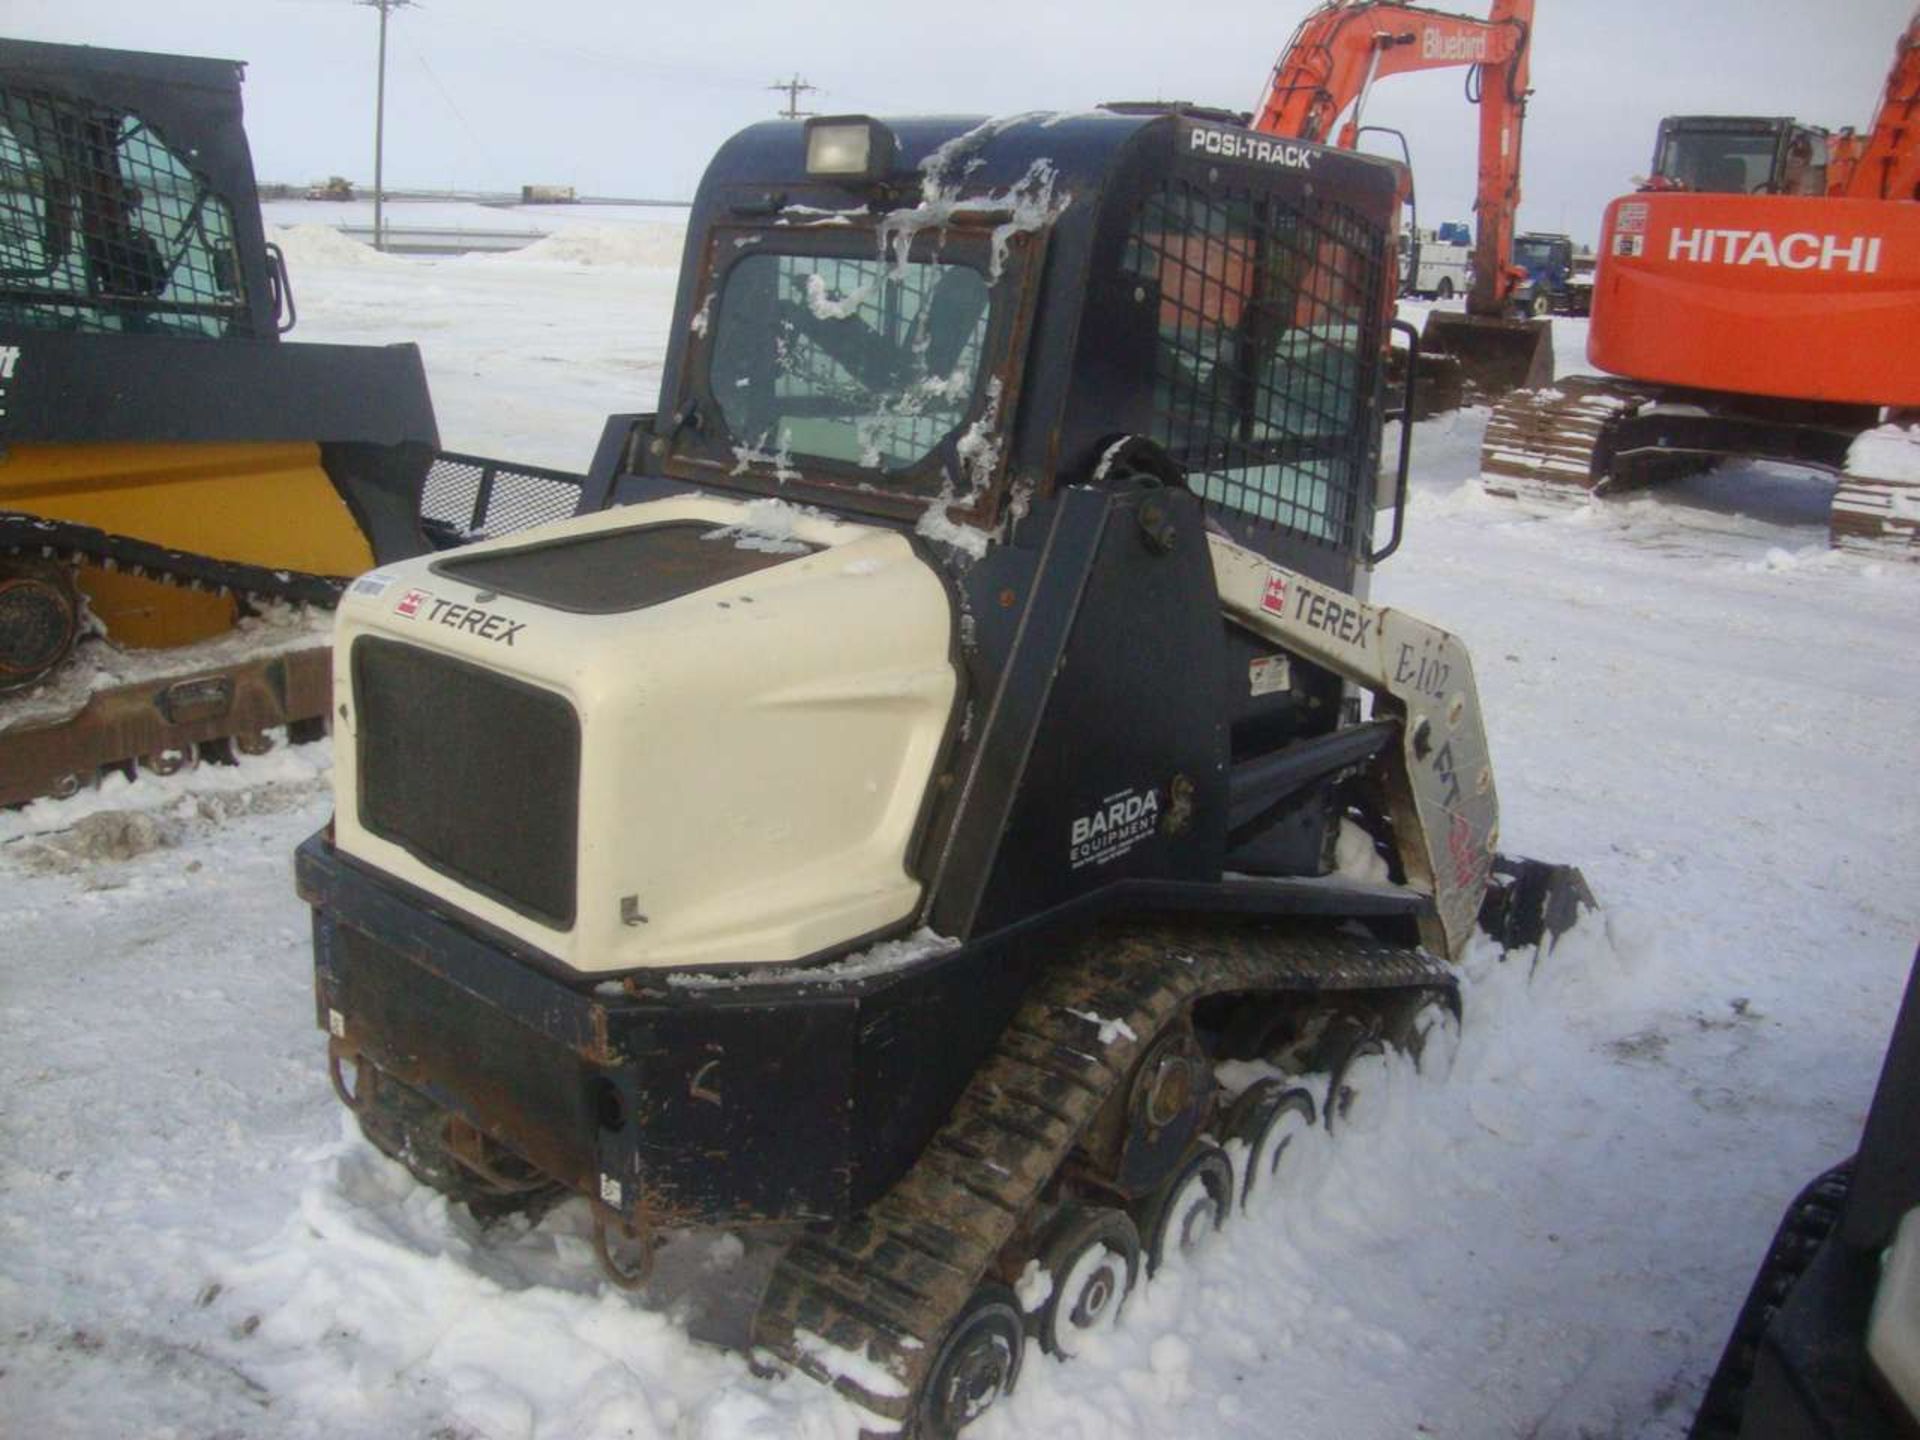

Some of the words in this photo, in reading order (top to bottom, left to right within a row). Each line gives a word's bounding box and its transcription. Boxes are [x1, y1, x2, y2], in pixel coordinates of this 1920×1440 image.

[1423, 26, 1487, 60] Bluebird
[1667, 227, 1882, 274] HITACHI
[427, 598, 527, 647] TEREX
[1295, 585, 1372, 649] TEREX
[1069, 813, 1158, 861] EQUIPMENT
[1071, 789, 1158, 846] BARDA
